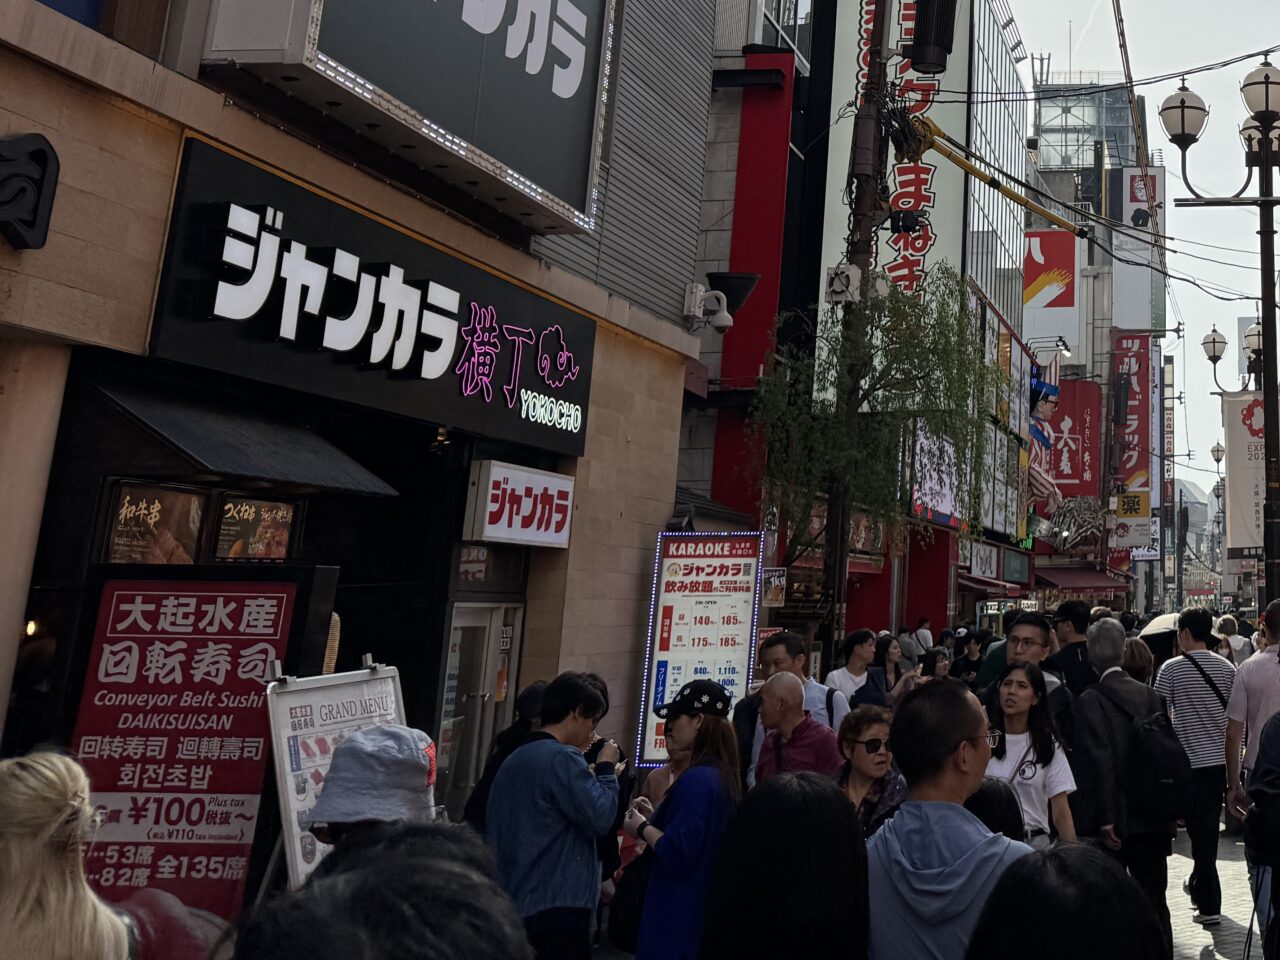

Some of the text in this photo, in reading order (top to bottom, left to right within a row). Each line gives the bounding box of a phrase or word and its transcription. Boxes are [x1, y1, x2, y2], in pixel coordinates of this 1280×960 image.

[213, 202, 461, 380] ジャンカラ
[519, 387, 582, 433] YOKOCHO
[487, 477, 570, 534] ジャンカラ
[1121, 495, 1141, 515] 薬
[668, 542, 731, 556] KARAOKE
[682, 562, 742, 577] ジャンカラ
[114, 595, 279, 635] 大起水産
[97, 639, 277, 685] 回転寿司
[94, 690, 265, 709] Conveyor Belt Sushi
[319, 696, 389, 722] GRAND MENU
[117, 713, 233, 731] DAIKISUISAN
[79, 736, 265, 761] 回转寿司 迴轉壽司
[117, 763, 214, 790] 회전초밥
[127, 796, 206, 826] ¥100
[207, 796, 246, 808] Plus tax
[155, 854, 248, 881] 全135席
